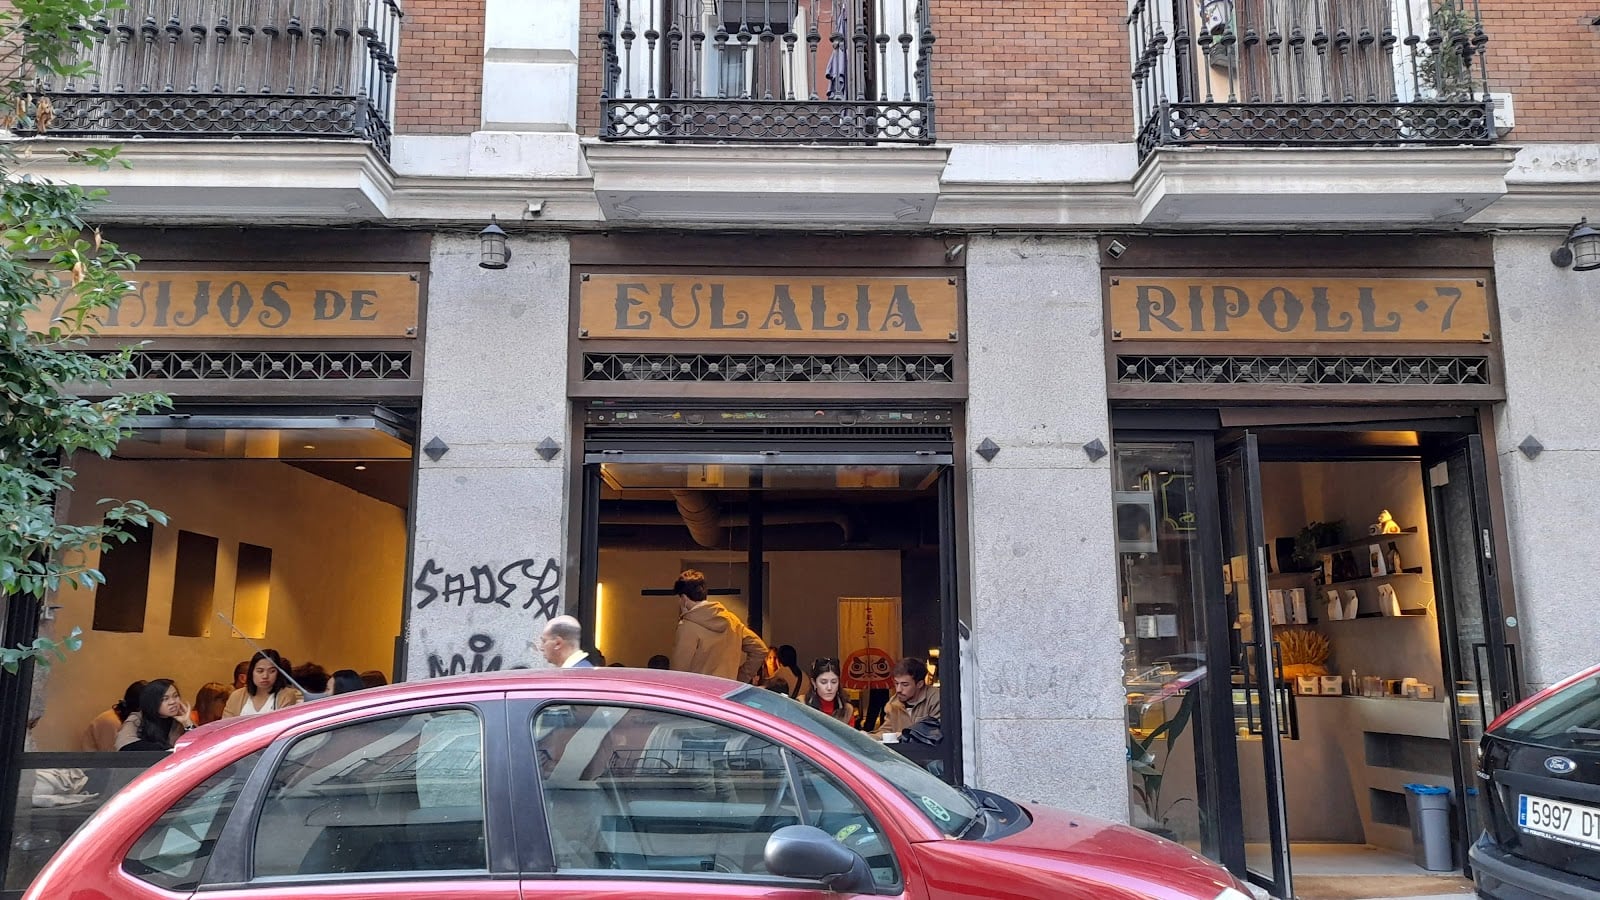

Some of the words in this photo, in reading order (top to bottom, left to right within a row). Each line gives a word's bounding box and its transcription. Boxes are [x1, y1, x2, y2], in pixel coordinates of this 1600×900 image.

[313, 289, 379, 321] DE
[614, 283, 923, 332] EULALIA
[1136, 285, 1401, 333] RIPOLL
[1532, 801, 1572, 831] 5997
